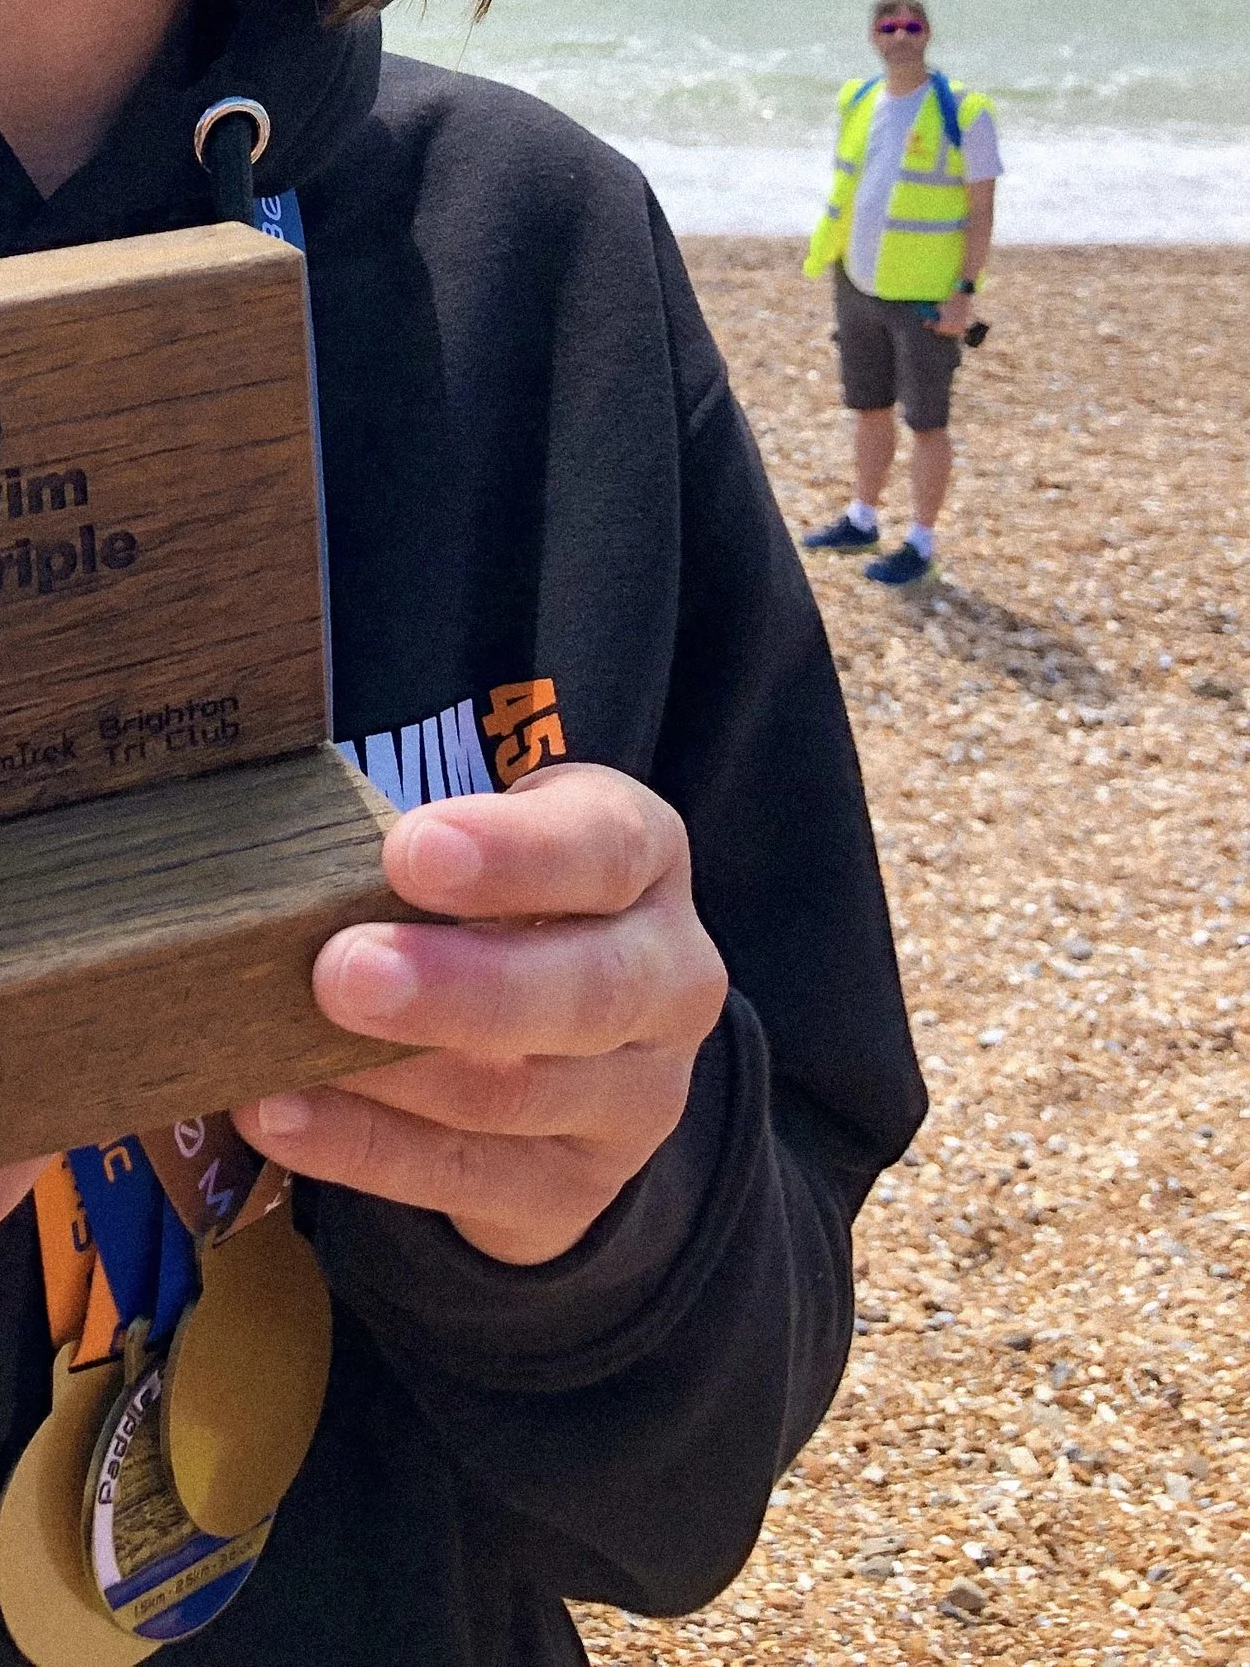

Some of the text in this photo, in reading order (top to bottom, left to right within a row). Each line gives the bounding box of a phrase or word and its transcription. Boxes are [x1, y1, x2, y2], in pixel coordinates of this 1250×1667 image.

[99, 695, 239, 740] Brighton
[482, 677, 566, 787] 45
[102, 719, 240, 767] Tri Club
